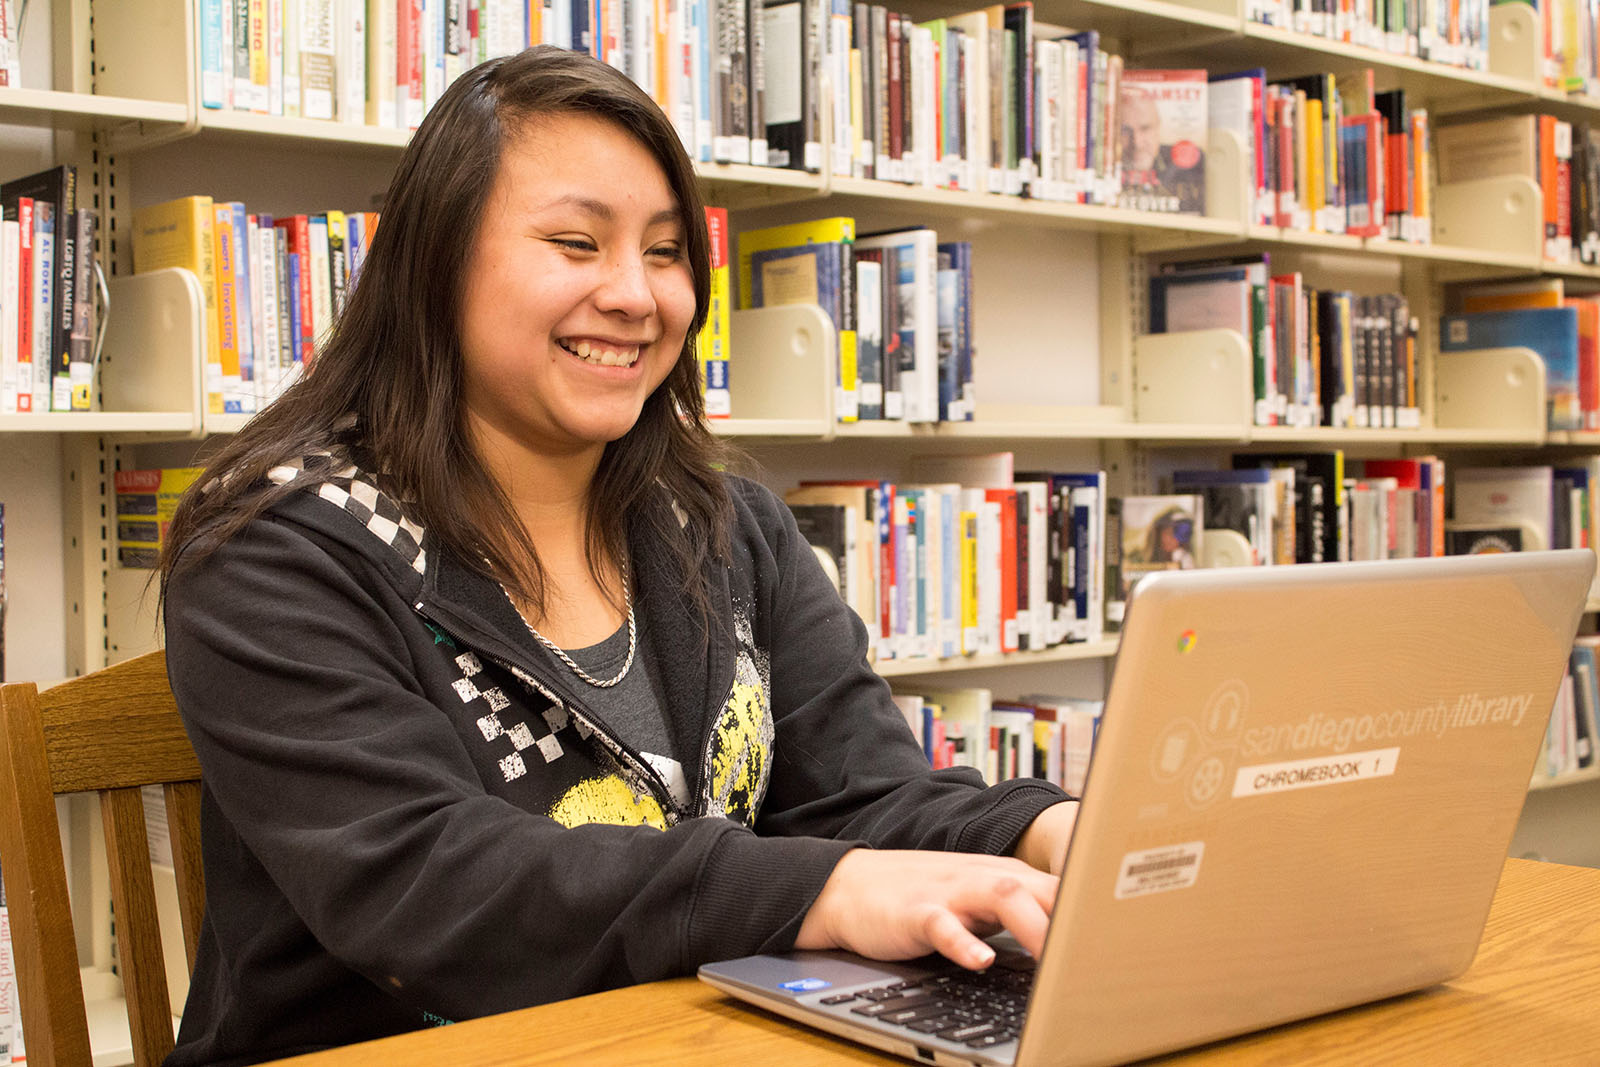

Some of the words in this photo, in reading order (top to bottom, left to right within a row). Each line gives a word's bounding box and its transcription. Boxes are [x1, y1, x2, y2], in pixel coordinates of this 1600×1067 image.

[42, 239, 50, 254] AL
[61, 238, 74, 279] LGBTQ
[202, 231, 213, 255] JUST
[264, 231, 273, 260] YOUR
[41, 260, 50, 304] ROKER
[203, 256, 214, 277] ONE
[264, 264, 274, 298] GUIDE
[61, 279, 74, 331] FAMILIES
[204, 280, 214, 309] THING
[222, 282, 234, 350] Investing
[266, 332, 276, 369] LOANS
[1253, 762, 1363, 790] CHROMEBOOK
[1373, 758, 1381, 774] 1
